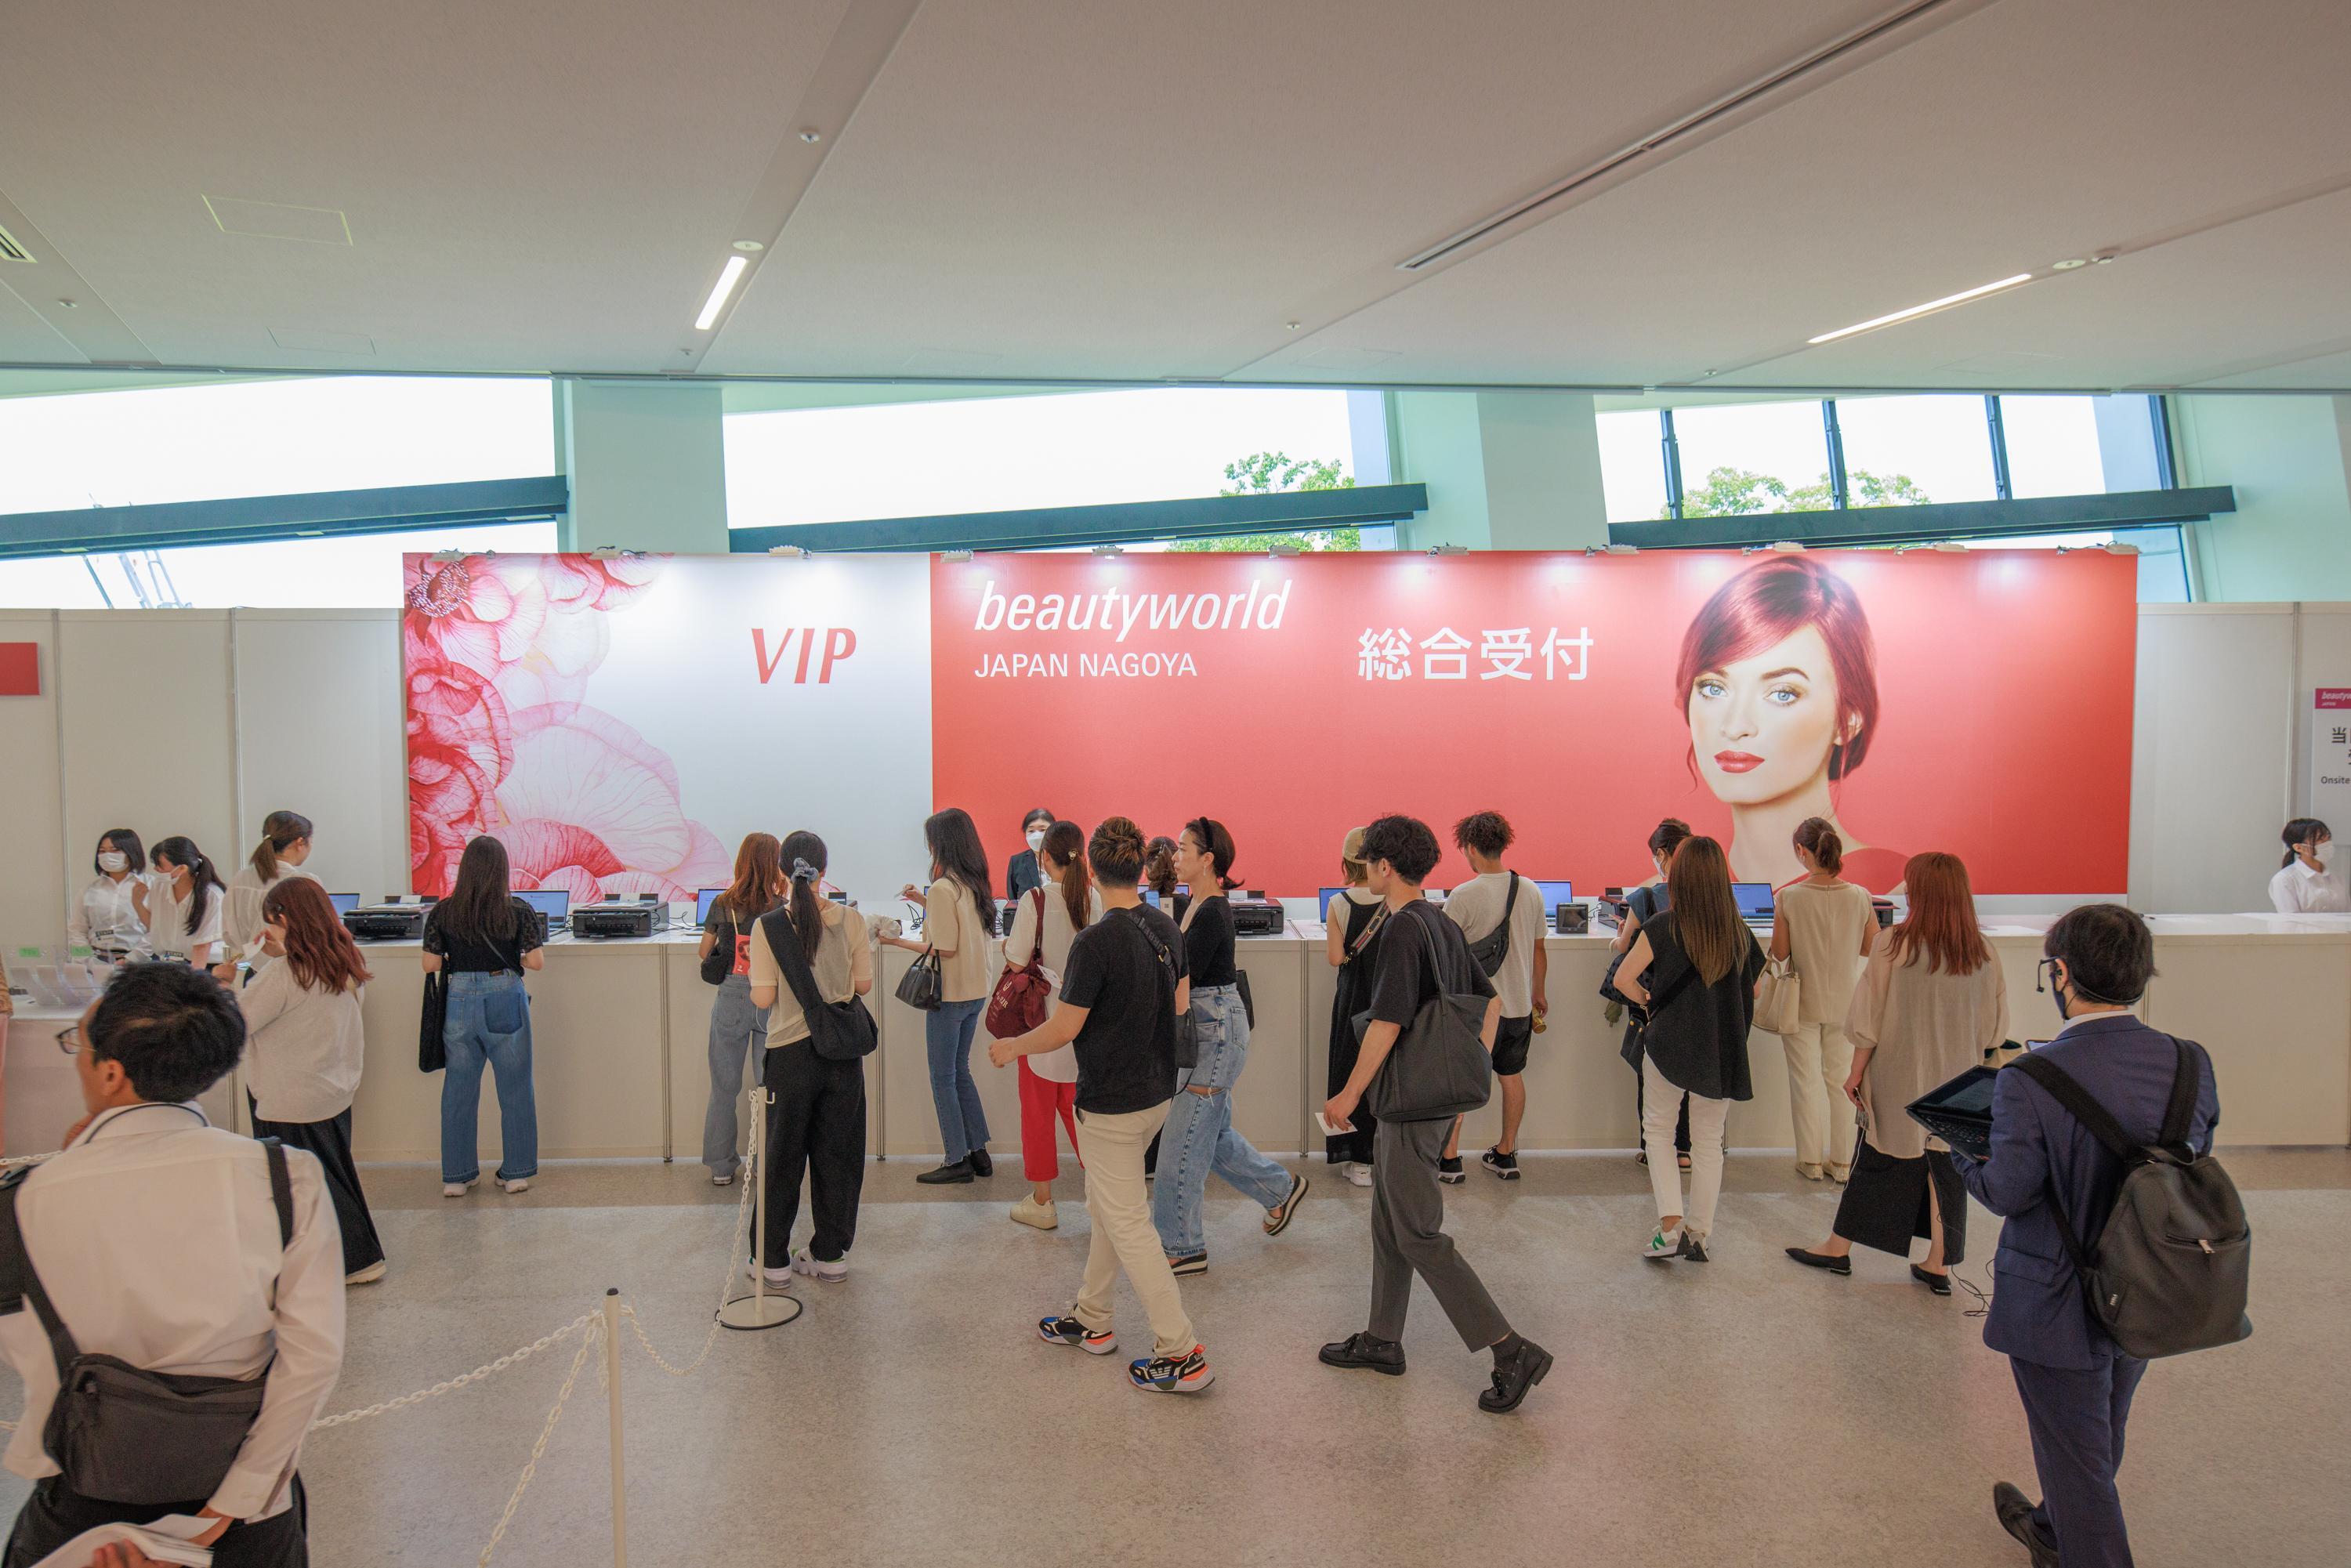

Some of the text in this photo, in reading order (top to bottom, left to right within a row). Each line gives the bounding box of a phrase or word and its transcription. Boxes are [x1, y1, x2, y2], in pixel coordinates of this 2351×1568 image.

[974, 580, 1293, 642] beautyworld
[752, 628, 857, 684] VIP
[974, 652, 1198, 678] JAPAN NAGOYA
[1357, 626, 1594, 681] 総合受付
[2332, 726, 2351, 744] 当
[2320, 776, 2350, 784] Onsite
